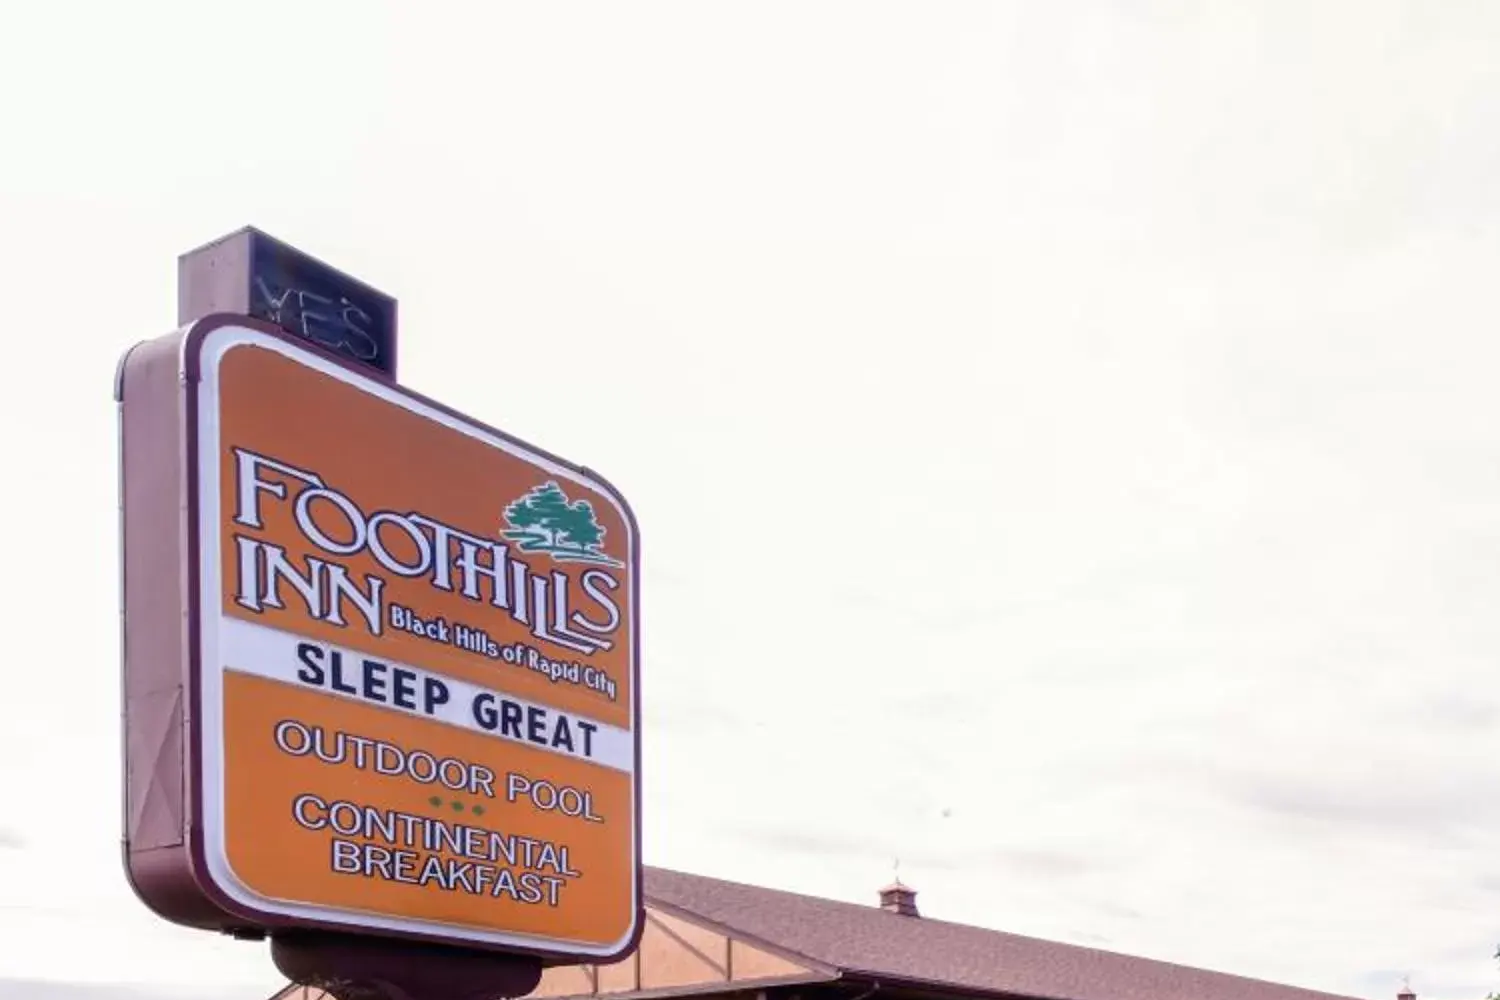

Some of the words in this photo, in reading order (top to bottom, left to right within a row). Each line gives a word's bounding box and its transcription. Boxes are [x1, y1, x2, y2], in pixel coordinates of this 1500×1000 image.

[232, 446, 622, 655] FOOTHILLS
[233, 533, 385, 637] INN
[296, 642, 450, 716] SLEEP
[472, 692, 599, 758] GREAT
[390, 603, 450, 643] Black
[455, 622, 499, 658] Hills
[502, 643, 527, 668] of
[526, 647, 580, 685] Rapid
[584, 665, 618, 700] City
[273, 718, 495, 798] OUTDOOR
[506, 772, 605, 822] POOL
[292, 793, 582, 878] CONTINENTAL
[331, 840, 567, 907] BREAKFAST
